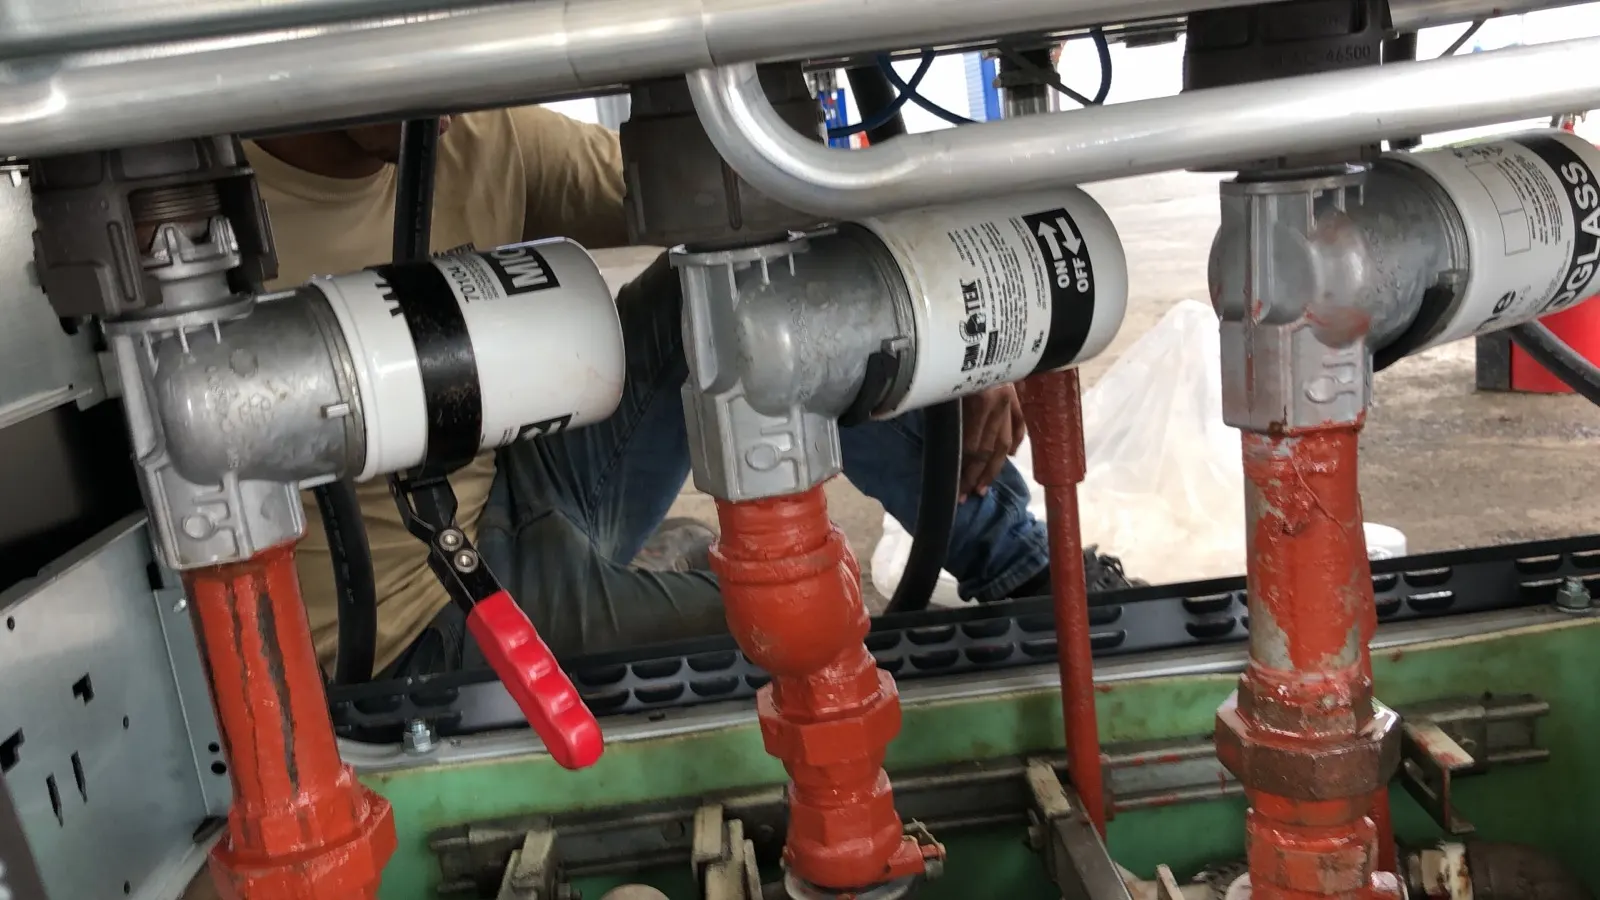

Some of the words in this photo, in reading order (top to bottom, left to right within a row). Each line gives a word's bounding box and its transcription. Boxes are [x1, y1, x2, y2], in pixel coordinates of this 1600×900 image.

[1053, 259, 1070, 289] ON
[1074, 257, 1089, 293] OFF
[961, 280, 981, 314] TEK
